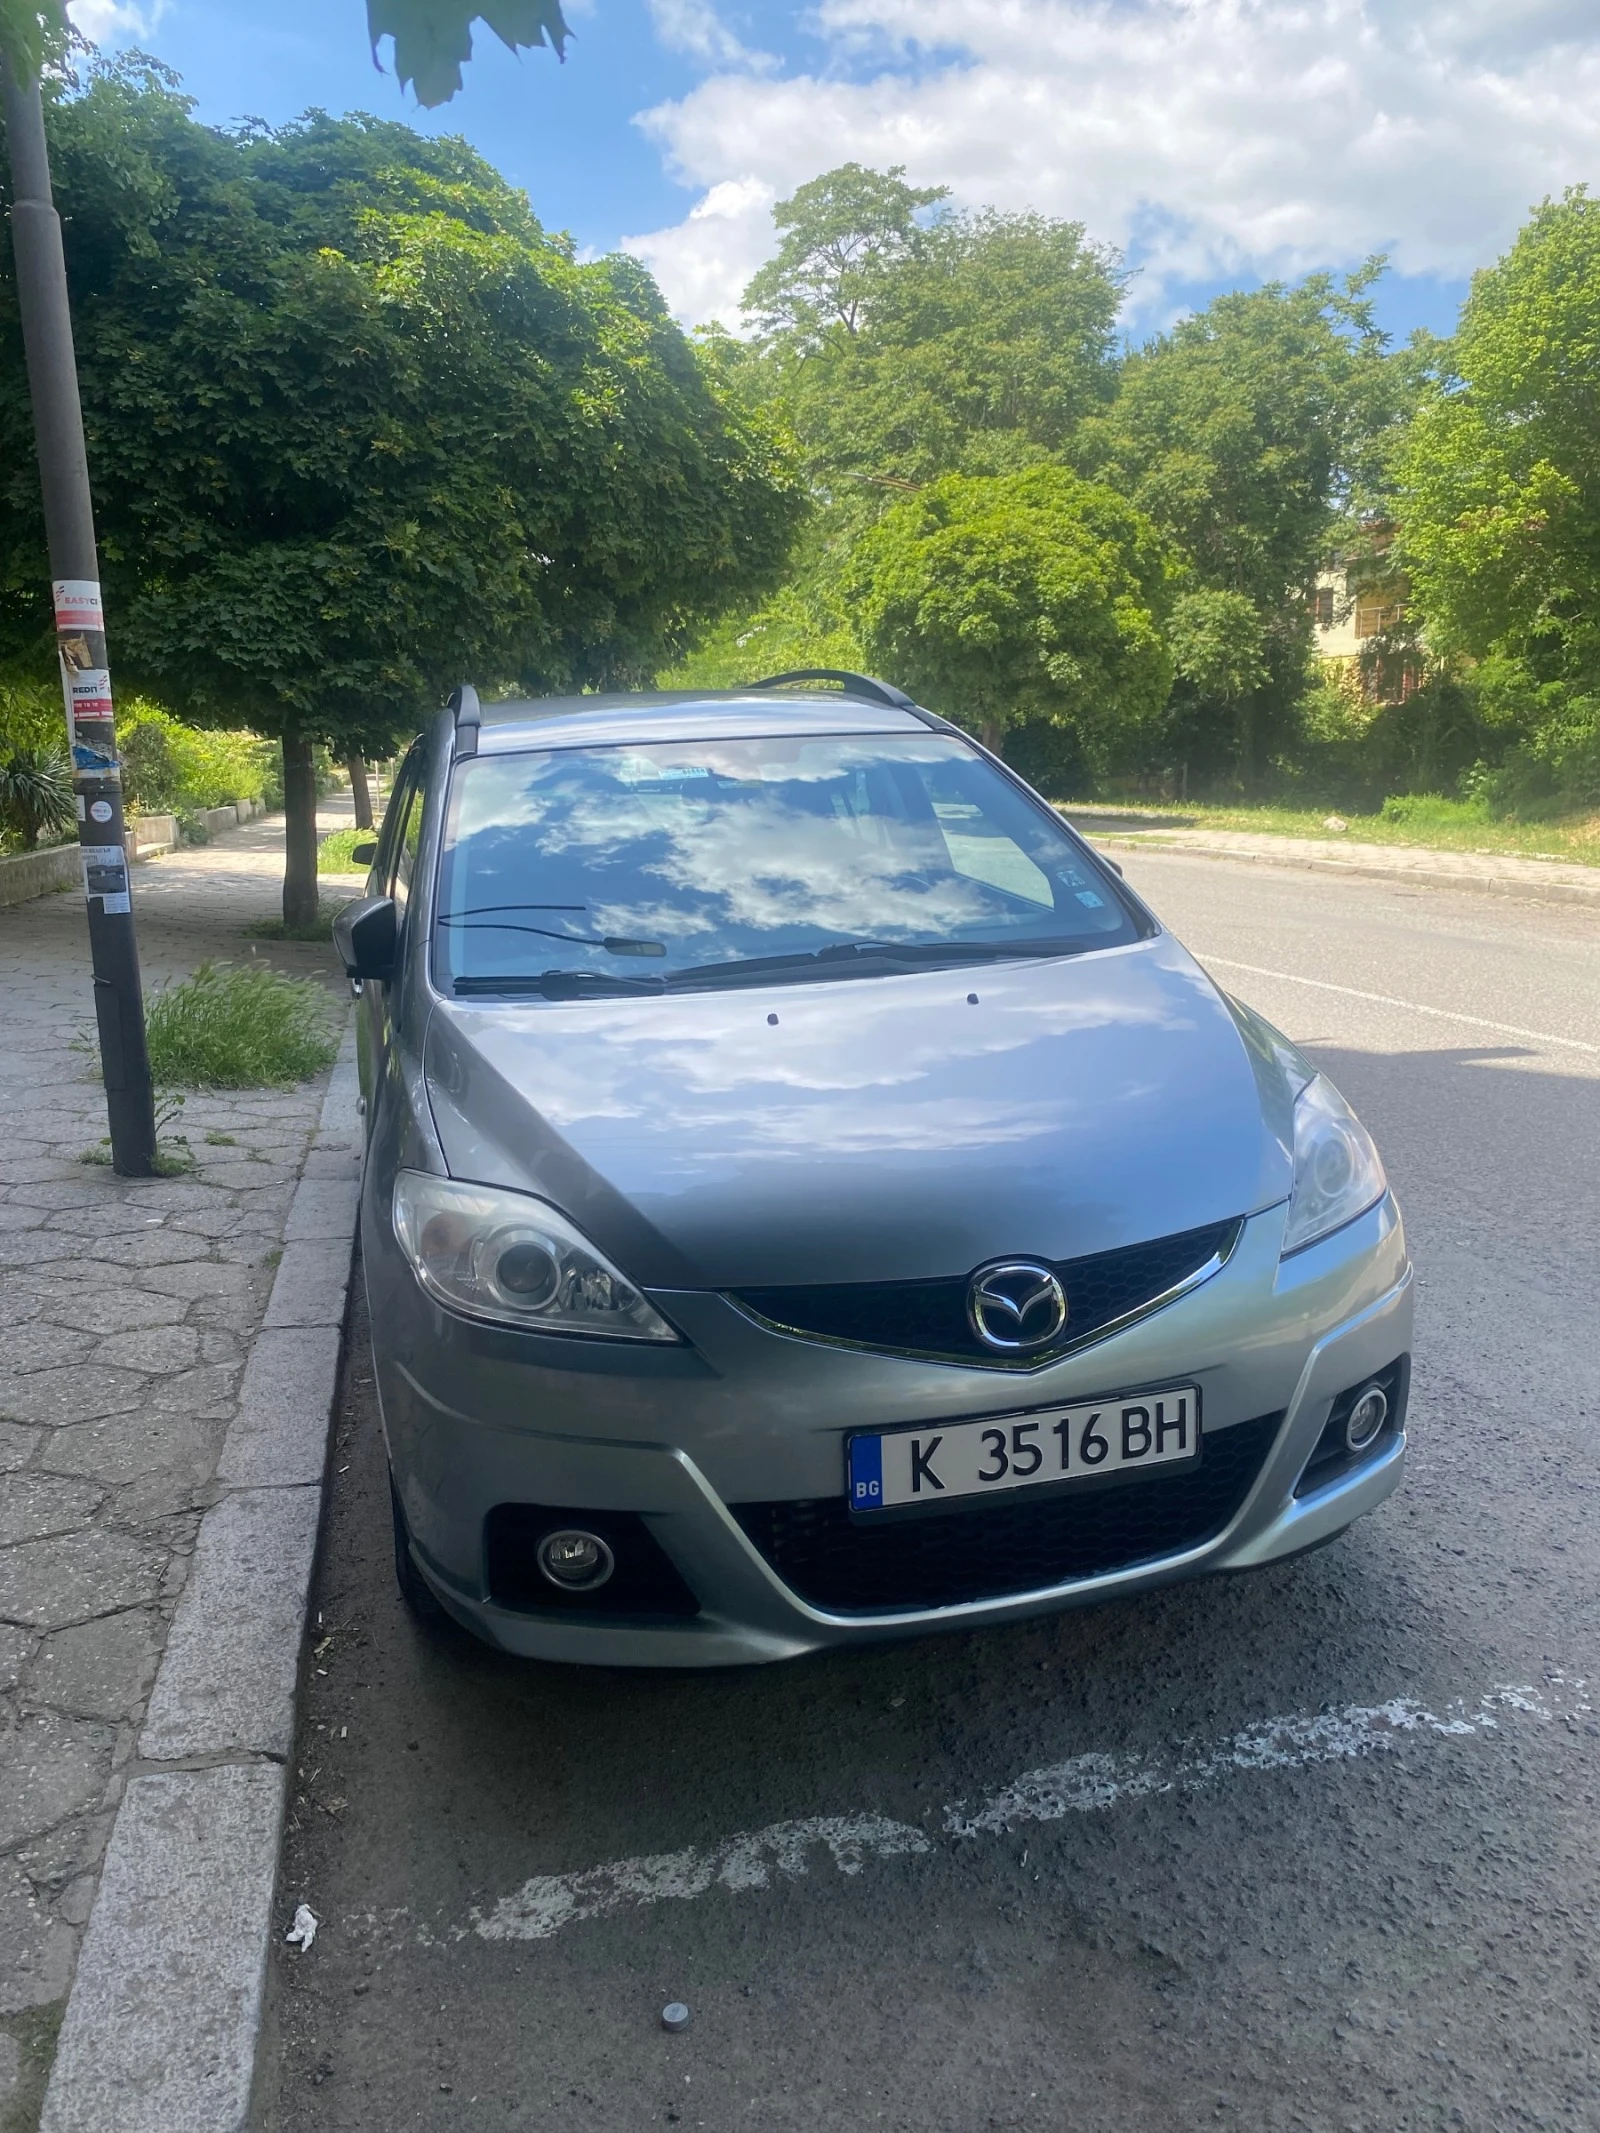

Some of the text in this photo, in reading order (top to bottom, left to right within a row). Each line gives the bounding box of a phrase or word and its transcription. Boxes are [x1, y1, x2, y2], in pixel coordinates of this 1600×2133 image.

[911, 1435, 946, 1493] K
[978, 1413, 1110, 1483] 3516
[856, 1480, 880, 1499] BG
